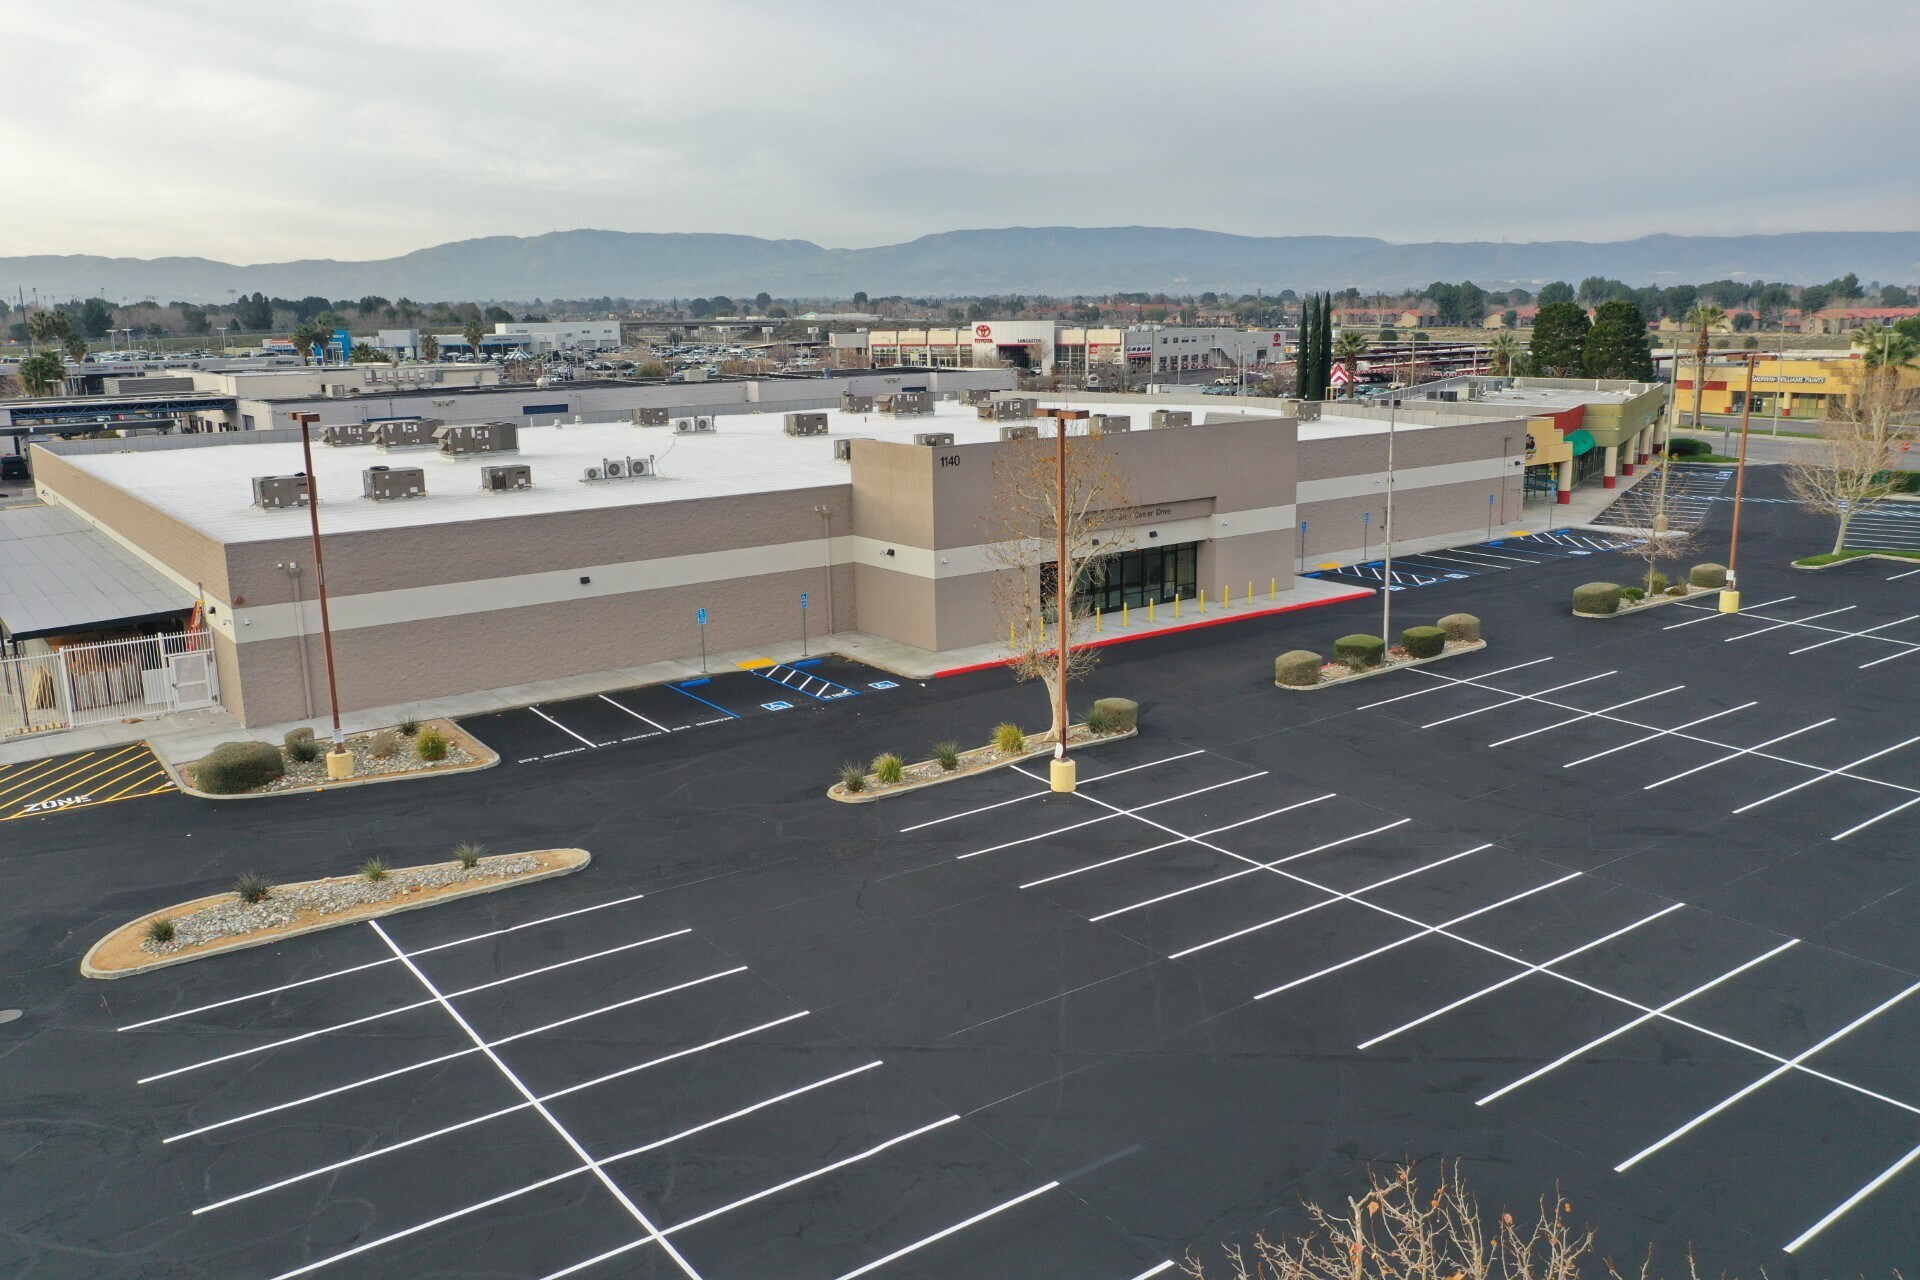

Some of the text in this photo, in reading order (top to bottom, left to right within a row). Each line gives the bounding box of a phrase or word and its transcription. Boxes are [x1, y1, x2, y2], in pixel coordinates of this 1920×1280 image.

[940, 455, 960, 467] 1140
[1134, 511, 1153, 519] Cener
[1156, 508, 1171, 516] Drive
[24, 794, 92, 812] ZONE
